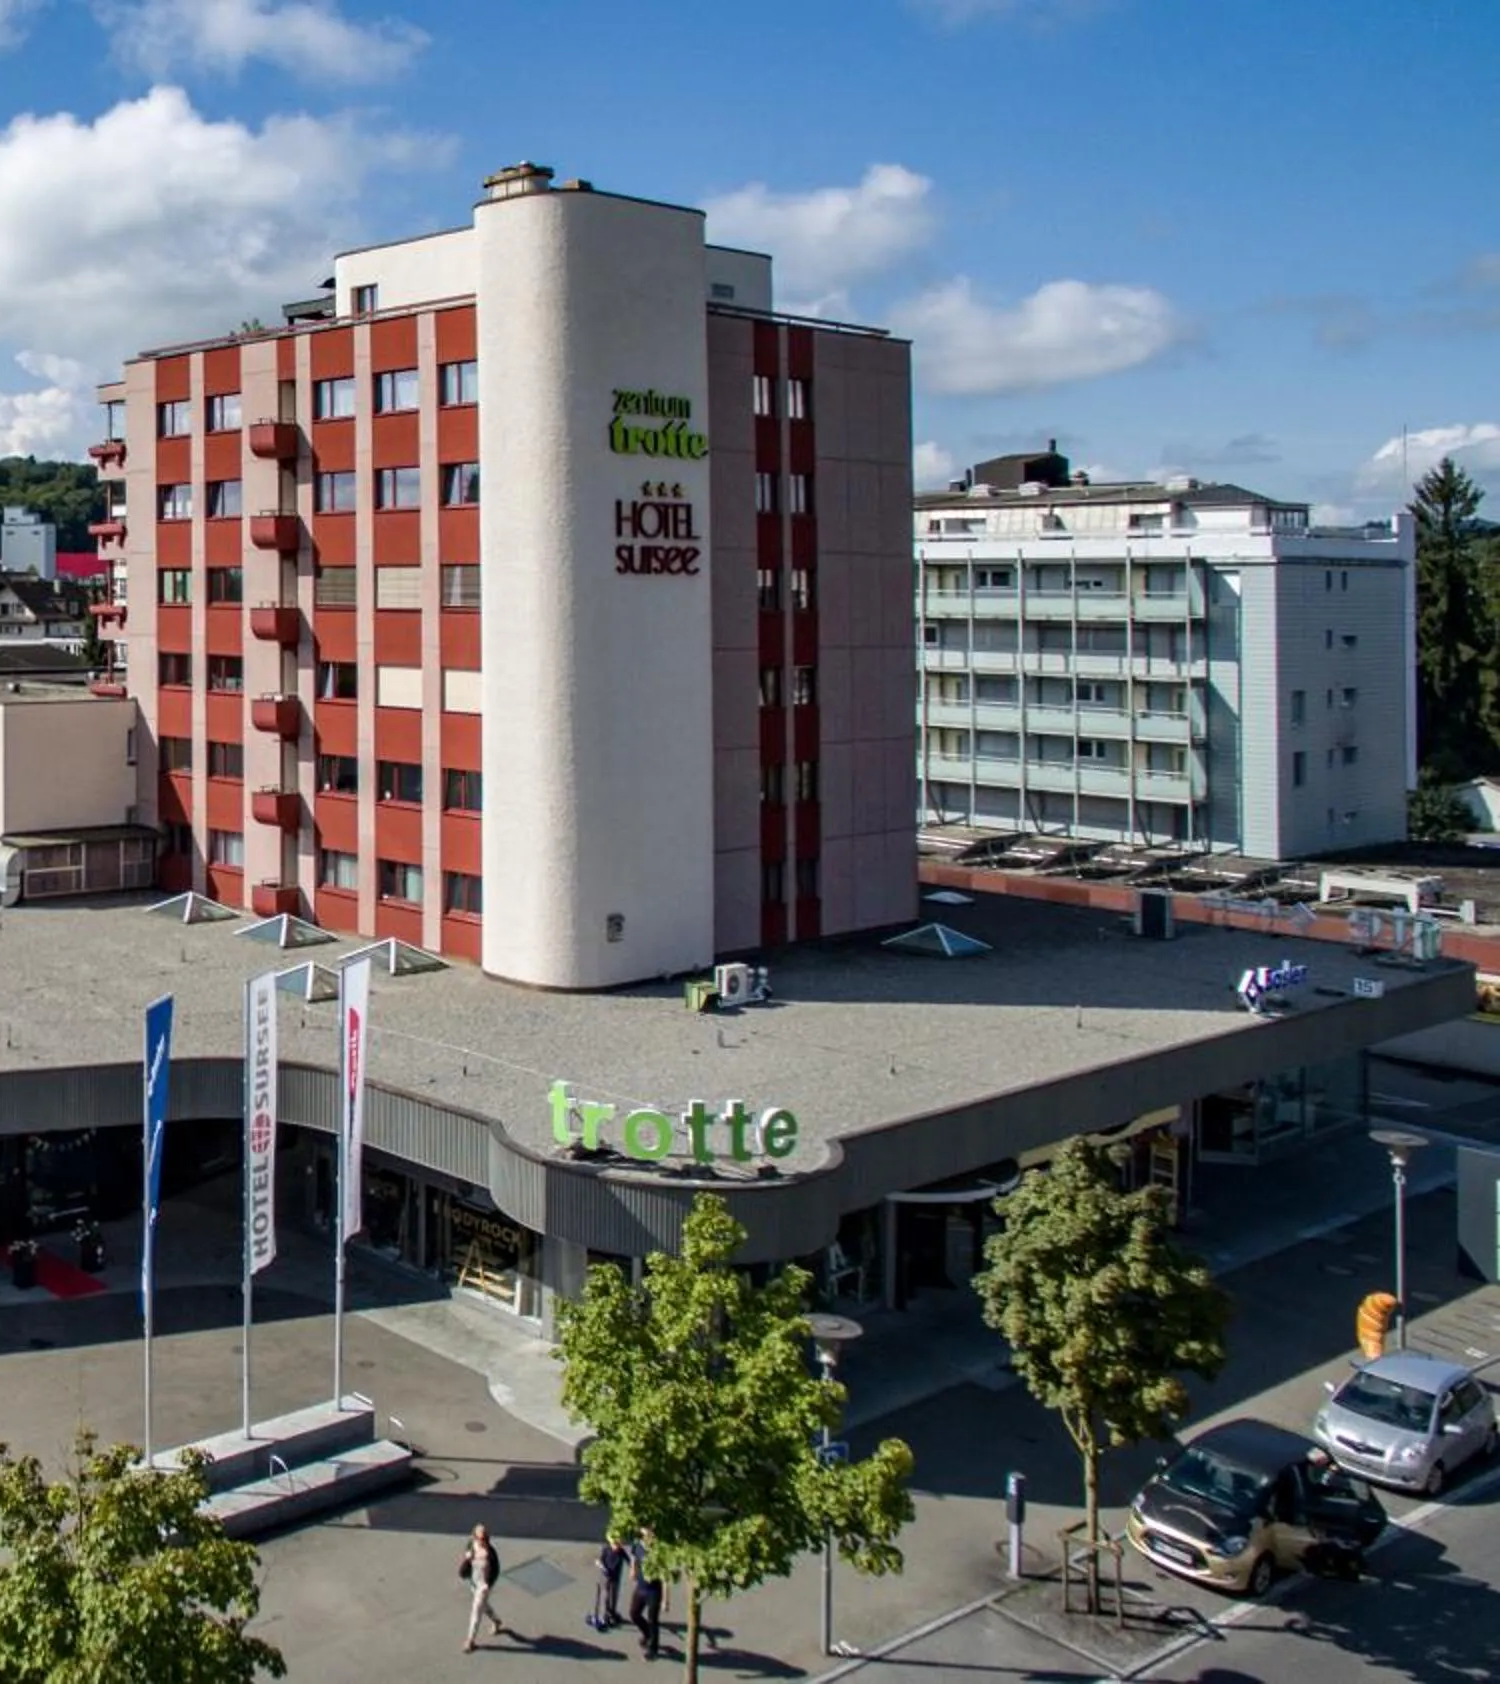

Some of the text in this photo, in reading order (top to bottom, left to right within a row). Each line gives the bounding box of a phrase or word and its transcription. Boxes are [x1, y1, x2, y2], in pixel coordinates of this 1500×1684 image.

[608, 414, 709, 460] trotte
[615, 498, 701, 540] HOTEL
[615, 543, 701, 576] sursee
[252, 988, 271, 1259] HOTEL SURSEE
[548, 1078, 798, 1163] trotte
